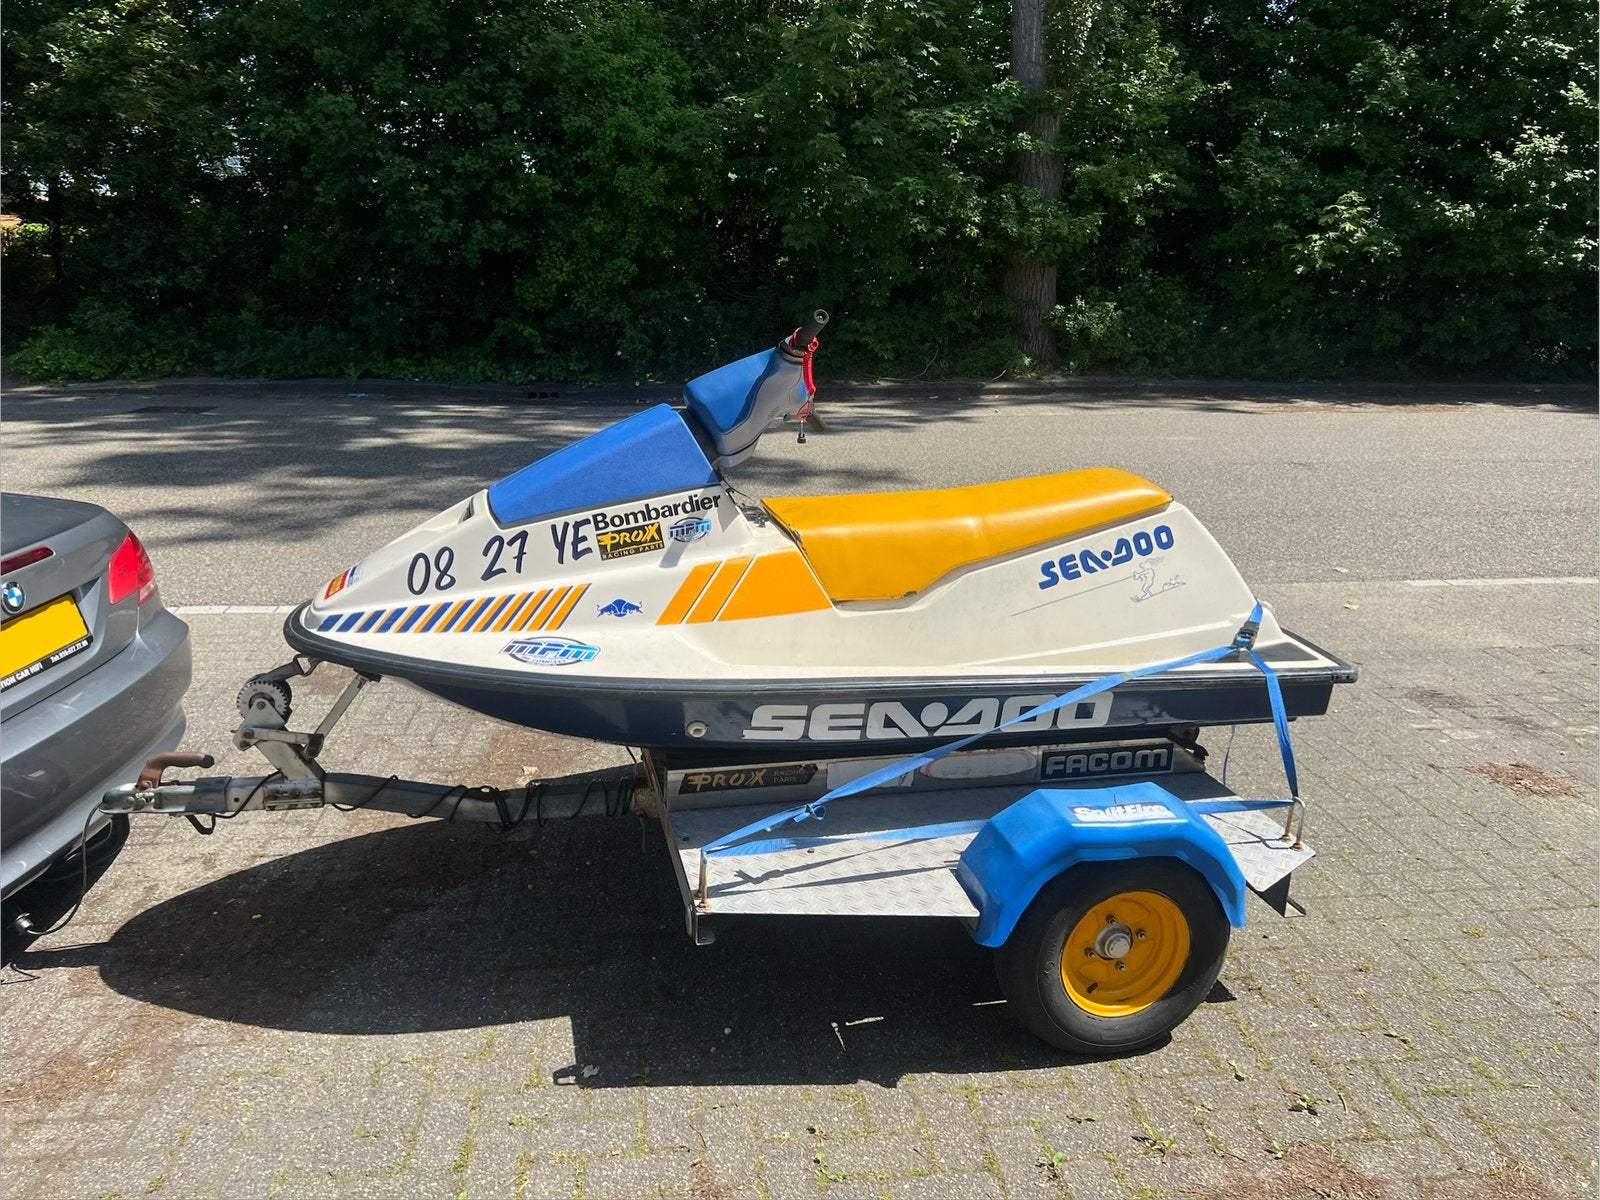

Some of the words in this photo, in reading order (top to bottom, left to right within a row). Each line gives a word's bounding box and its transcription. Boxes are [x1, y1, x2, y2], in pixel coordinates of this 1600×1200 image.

[592, 494, 720, 531] Bombardier
[407, 546, 457, 596] 08
[480, 530, 530, 582] 27
[550, 518, 593, 565] YE
[602, 548, 636, 560] RACING
[639, 542, 664, 553] PARTS
[16, 668, 31, 681] CAR
[774, 767, 806, 777] RACING
[1046, 748, 1168, 775] FACOM
